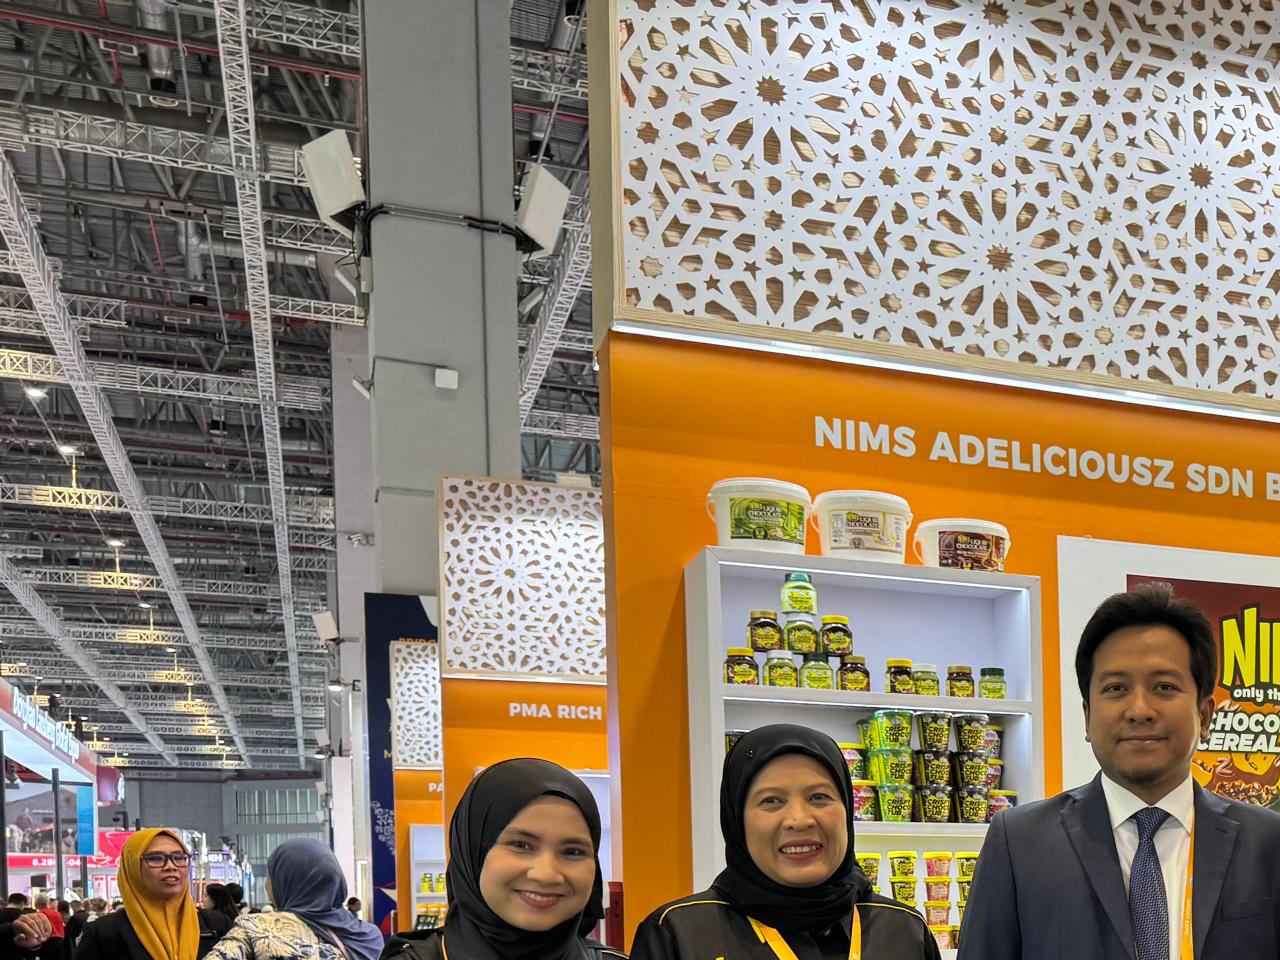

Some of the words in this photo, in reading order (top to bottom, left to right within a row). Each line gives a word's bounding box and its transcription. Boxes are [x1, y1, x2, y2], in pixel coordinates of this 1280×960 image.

[814, 417, 916, 457] NIMS
[930, 431, 1174, 490] ADELICIOUSZ
[1186, 462, 1255, 499] SDN
[352, 679, 361, 692] E
[1233, 687, 1265, 702] only
[509, 703, 552, 718] PMA
[558, 704, 603, 721] RICH
[1197, 732, 1280, 753] CEREAL
